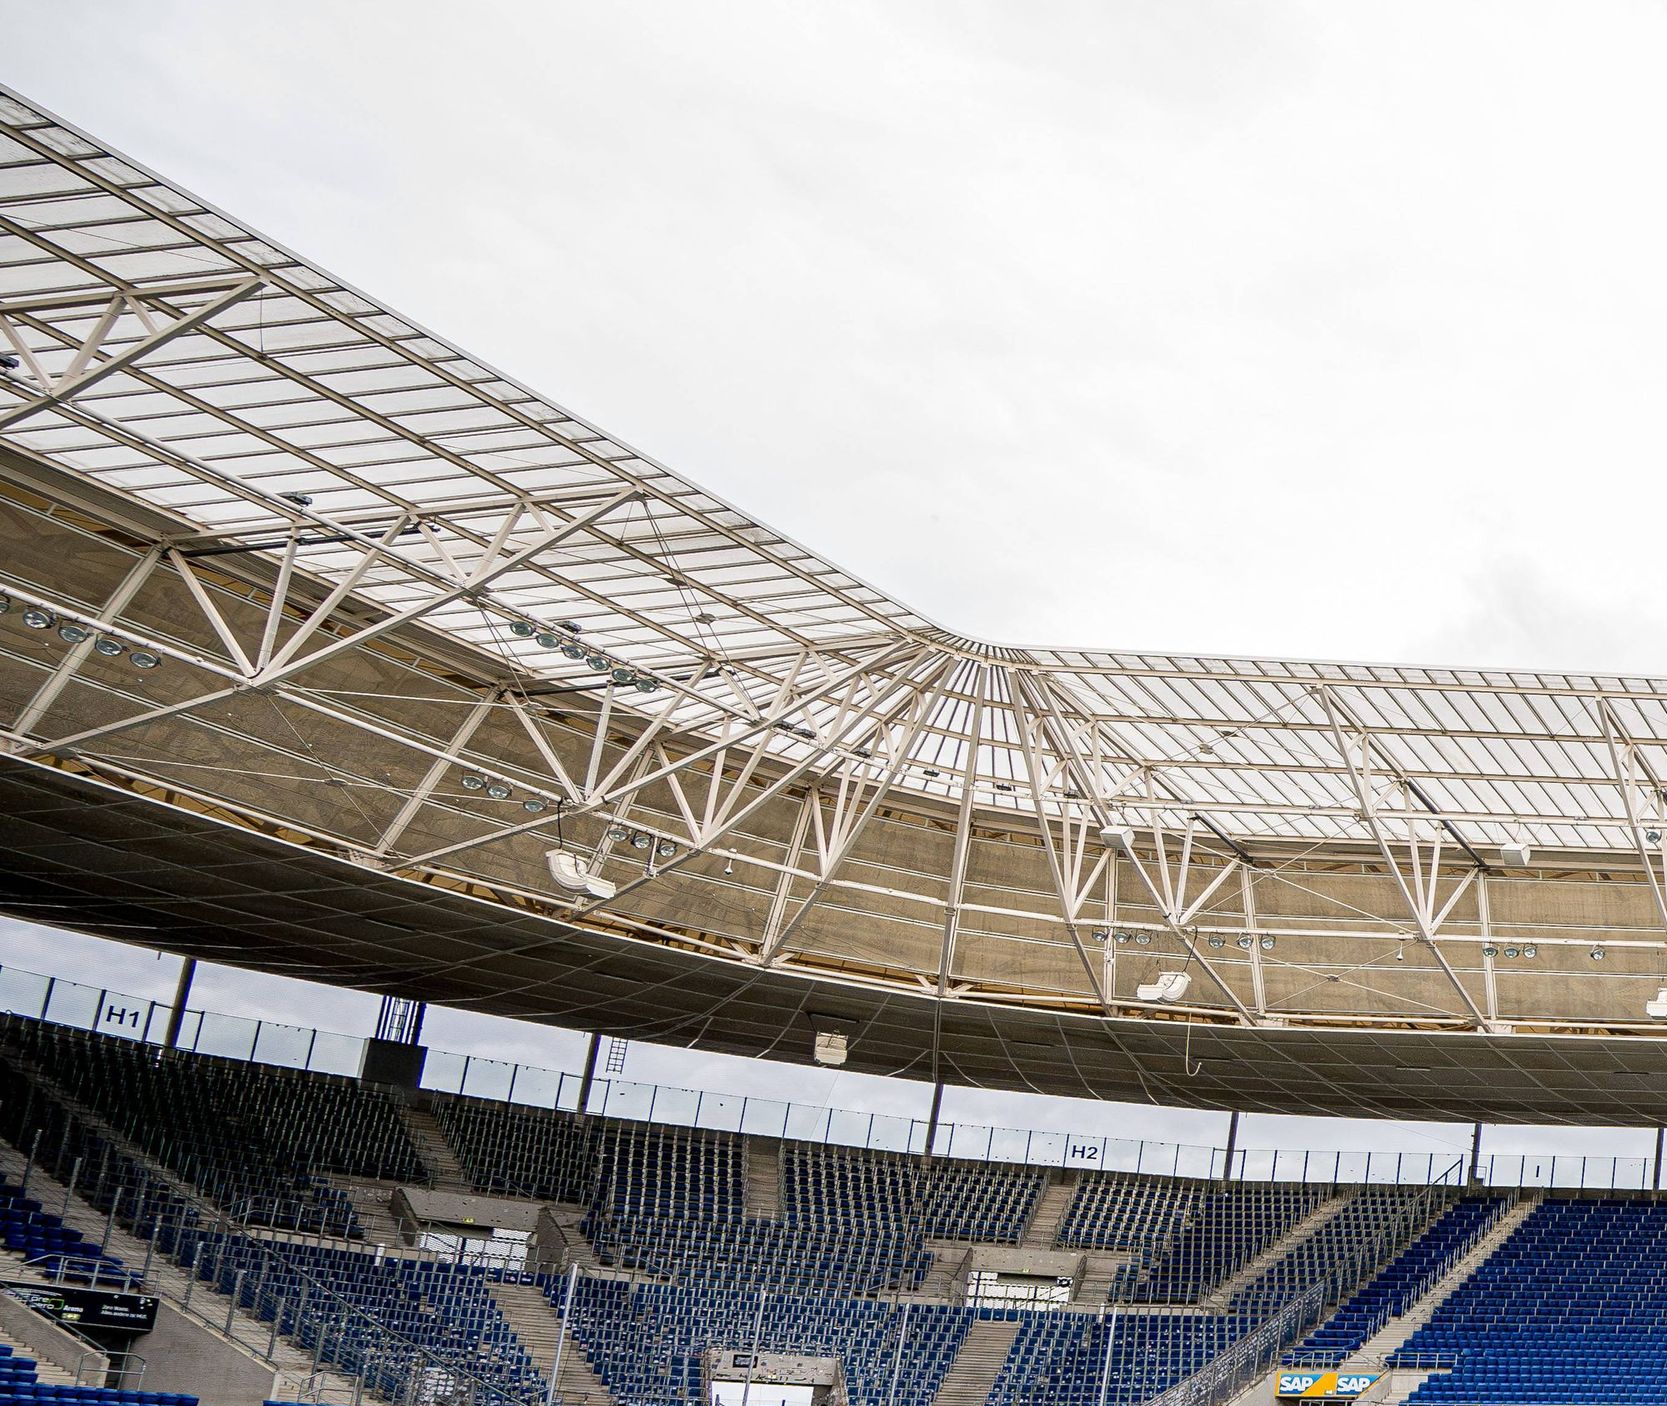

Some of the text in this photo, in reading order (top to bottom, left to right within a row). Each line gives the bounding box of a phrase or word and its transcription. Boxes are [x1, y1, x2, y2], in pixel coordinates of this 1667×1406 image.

[105, 1005, 140, 1028] H1
[1072, 1145, 1098, 1160] H2
[1536, 1165, 1540, 1178] I
[1280, 1376, 1313, 1392] SAP
[1337, 1377, 1370, 1392] SAP
